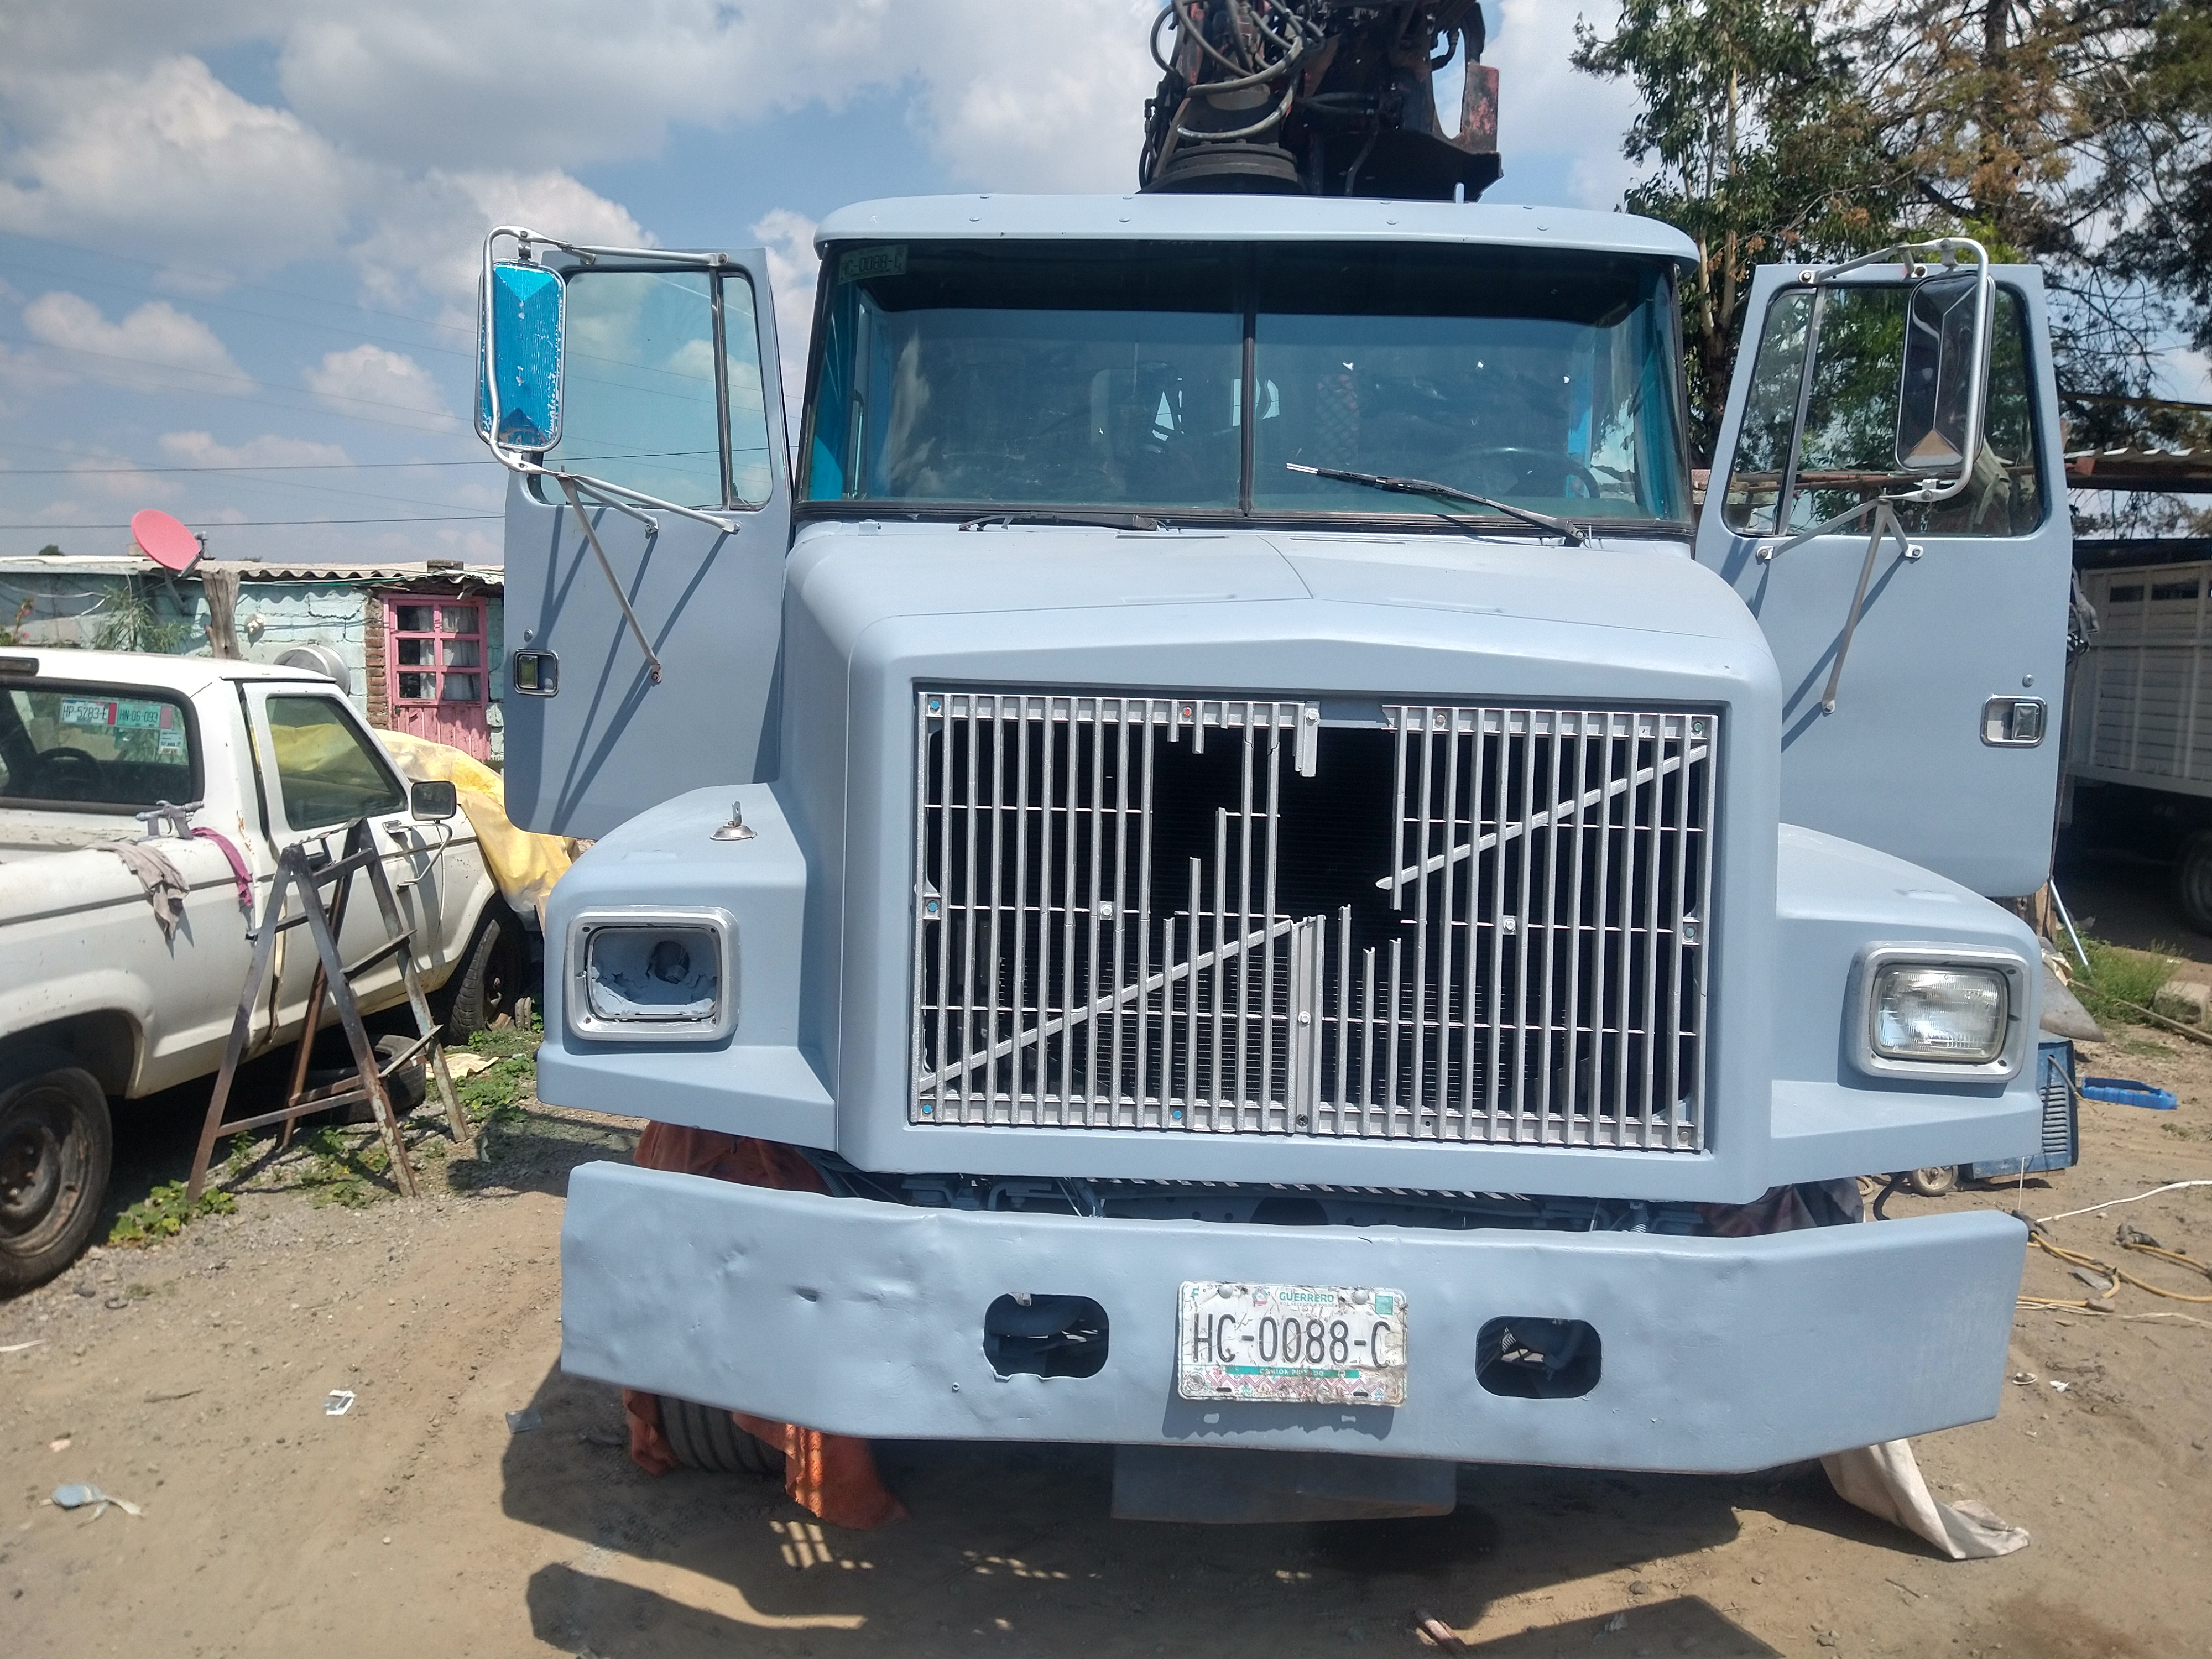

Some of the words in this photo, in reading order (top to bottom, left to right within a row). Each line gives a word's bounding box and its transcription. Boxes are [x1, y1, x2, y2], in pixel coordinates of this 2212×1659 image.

[841, 253, 902, 277] HC-0088-C
[1279, 1292, 1334, 1302] GUERRERO
[1193, 1313, 1391, 1369] HC-0088-C
